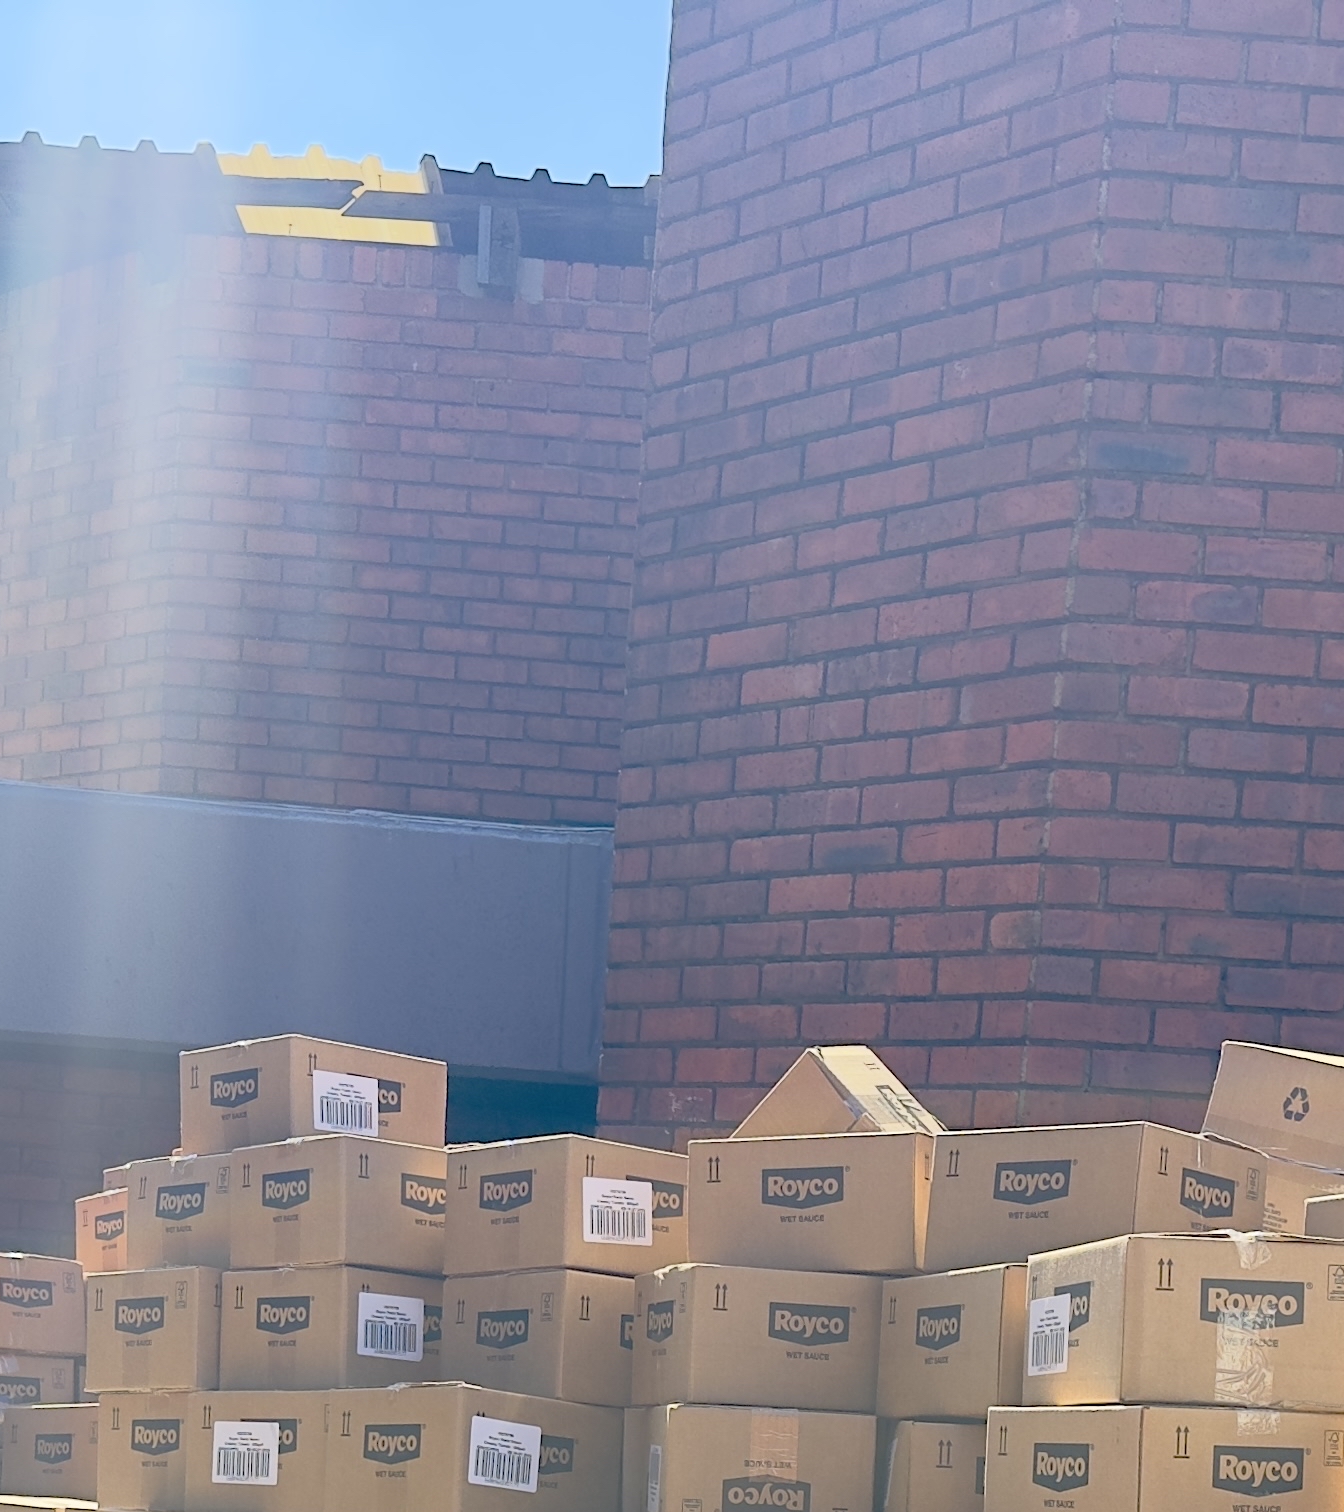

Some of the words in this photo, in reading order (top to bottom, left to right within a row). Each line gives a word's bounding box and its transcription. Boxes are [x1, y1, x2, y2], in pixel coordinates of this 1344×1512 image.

[213, 1078, 255, 1100] Royco
[265, 1180, 306, 1202] Royco
[406, 1181, 446, 1207] Royc
[483, 1180, 529, 1204] Royco
[767, 1176, 839, 1201] Royco
[999, 1170, 1066, 1197] Royco
[1184, 1180, 1231, 1210] Royco
[159, 1192, 201, 1213] Royco
[652, 1192, 680, 1210] yco
[96, 1218, 123, 1235] Royco
[780, 1215, 797, 1223] WET
[798, 1214, 825, 1223] SAUCE
[1008, 1211, 1023, 1220] WET
[1024, 1210, 1049, 1219] SAUCE
[2, 1283, 49, 1302] Royco
[118, 1304, 161, 1327] Royco
[260, 1304, 307, 1327] Royco
[648, 1311, 672, 1335] Royco
[774, 1310, 845, 1338] Royco
[480, 1317, 525, 1341] Royco
[919, 1316, 958, 1343] Royco
[786, 1351, 803, 1360] WET
[804, 1352, 830, 1361] SAUCE
[134, 1426, 177, 1448] Royco
[367, 1431, 418, 1456] Royco
[37, 1440, 70, 1458] Royco
[541, 1445, 570, 1468] yco
[1036, 1452, 1086, 1483] Royco
[1218, 1454, 1298, 1487] Royco
[728, 1483, 805, 1511] Royco
[1044, 1499, 1056, 1509] WET
[1056, 1500, 1075, 1509] SAUCE
